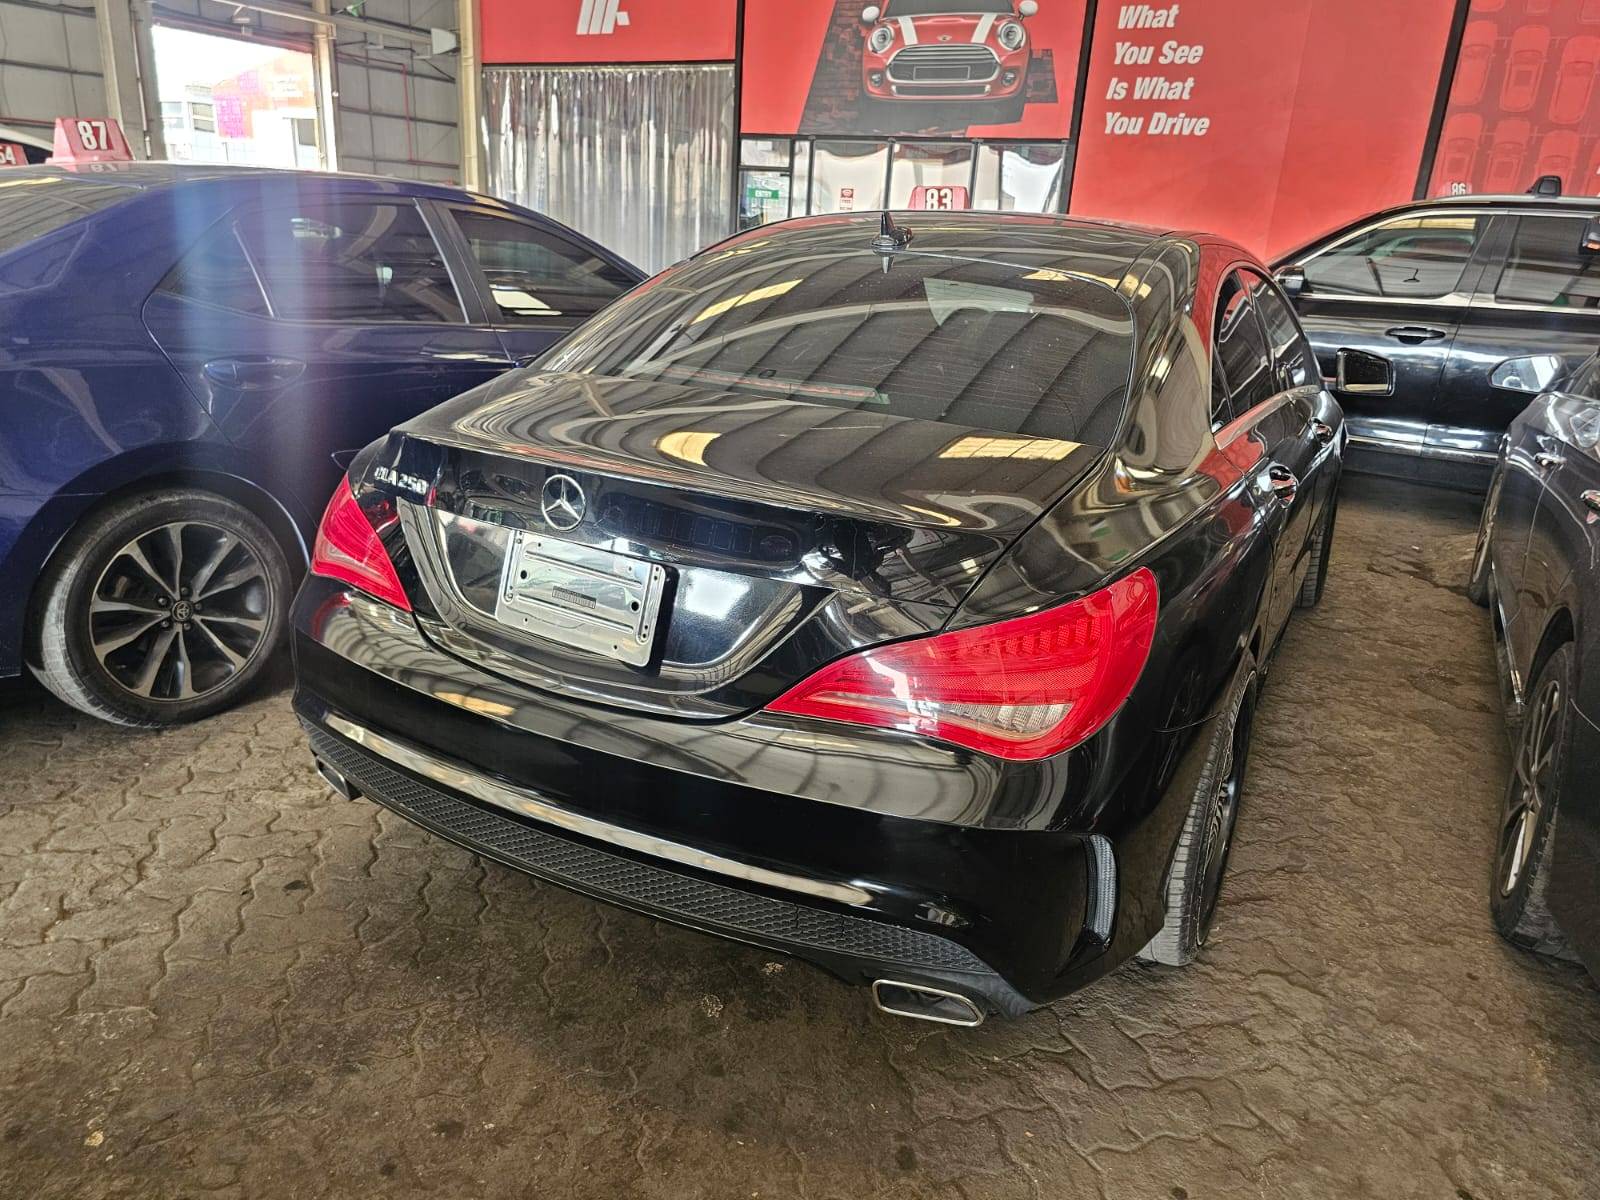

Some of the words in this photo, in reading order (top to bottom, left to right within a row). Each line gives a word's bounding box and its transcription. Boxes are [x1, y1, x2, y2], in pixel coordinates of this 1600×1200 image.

[1118, 4, 1179, 29] What
[1114, 41, 1155, 65] You
[1158, 40, 1204, 64] See
[1105, 77, 1129, 100] Is
[1133, 76, 1195, 100] What
[77, 121, 108, 150] 87
[1104, 111, 1144, 135] You
[1147, 111, 1210, 136] Drive
[926, 188, 953, 210] 83
